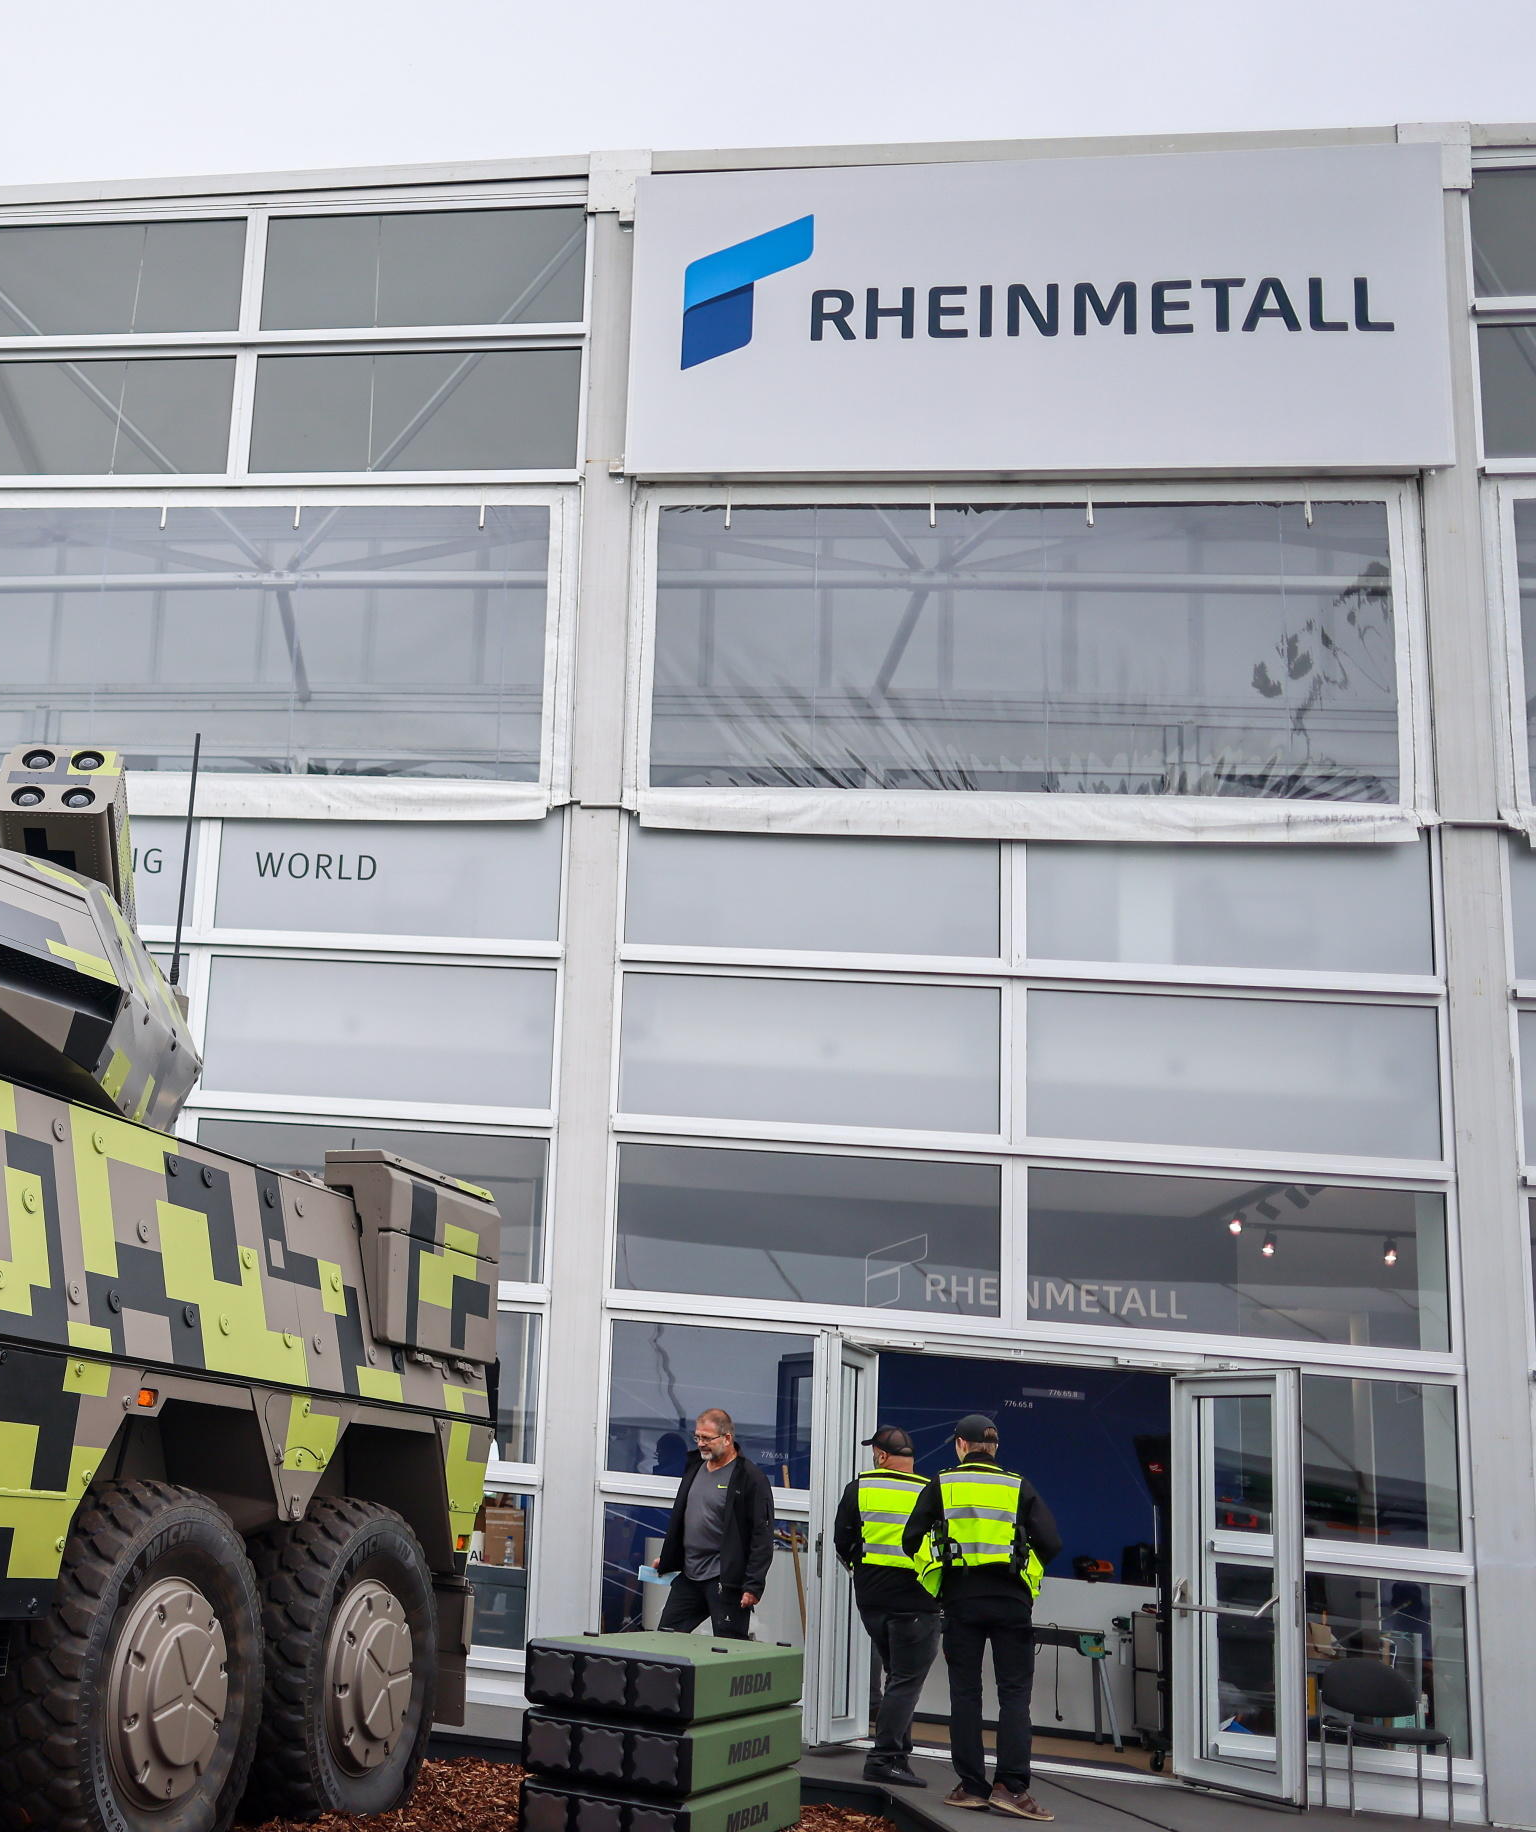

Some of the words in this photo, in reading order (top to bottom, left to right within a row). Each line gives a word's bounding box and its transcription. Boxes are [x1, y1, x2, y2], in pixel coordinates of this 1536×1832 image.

[810, 276, 1395, 341] RHEINMETALL
[255, 851, 378, 881] WORLD
[925, 1273, 1188, 1320] RHENMETALL
[729, 1671, 772, 1698] MBDA
[727, 1735, 771, 1766] MBDA
[726, 1801, 769, 1832] MBDA
